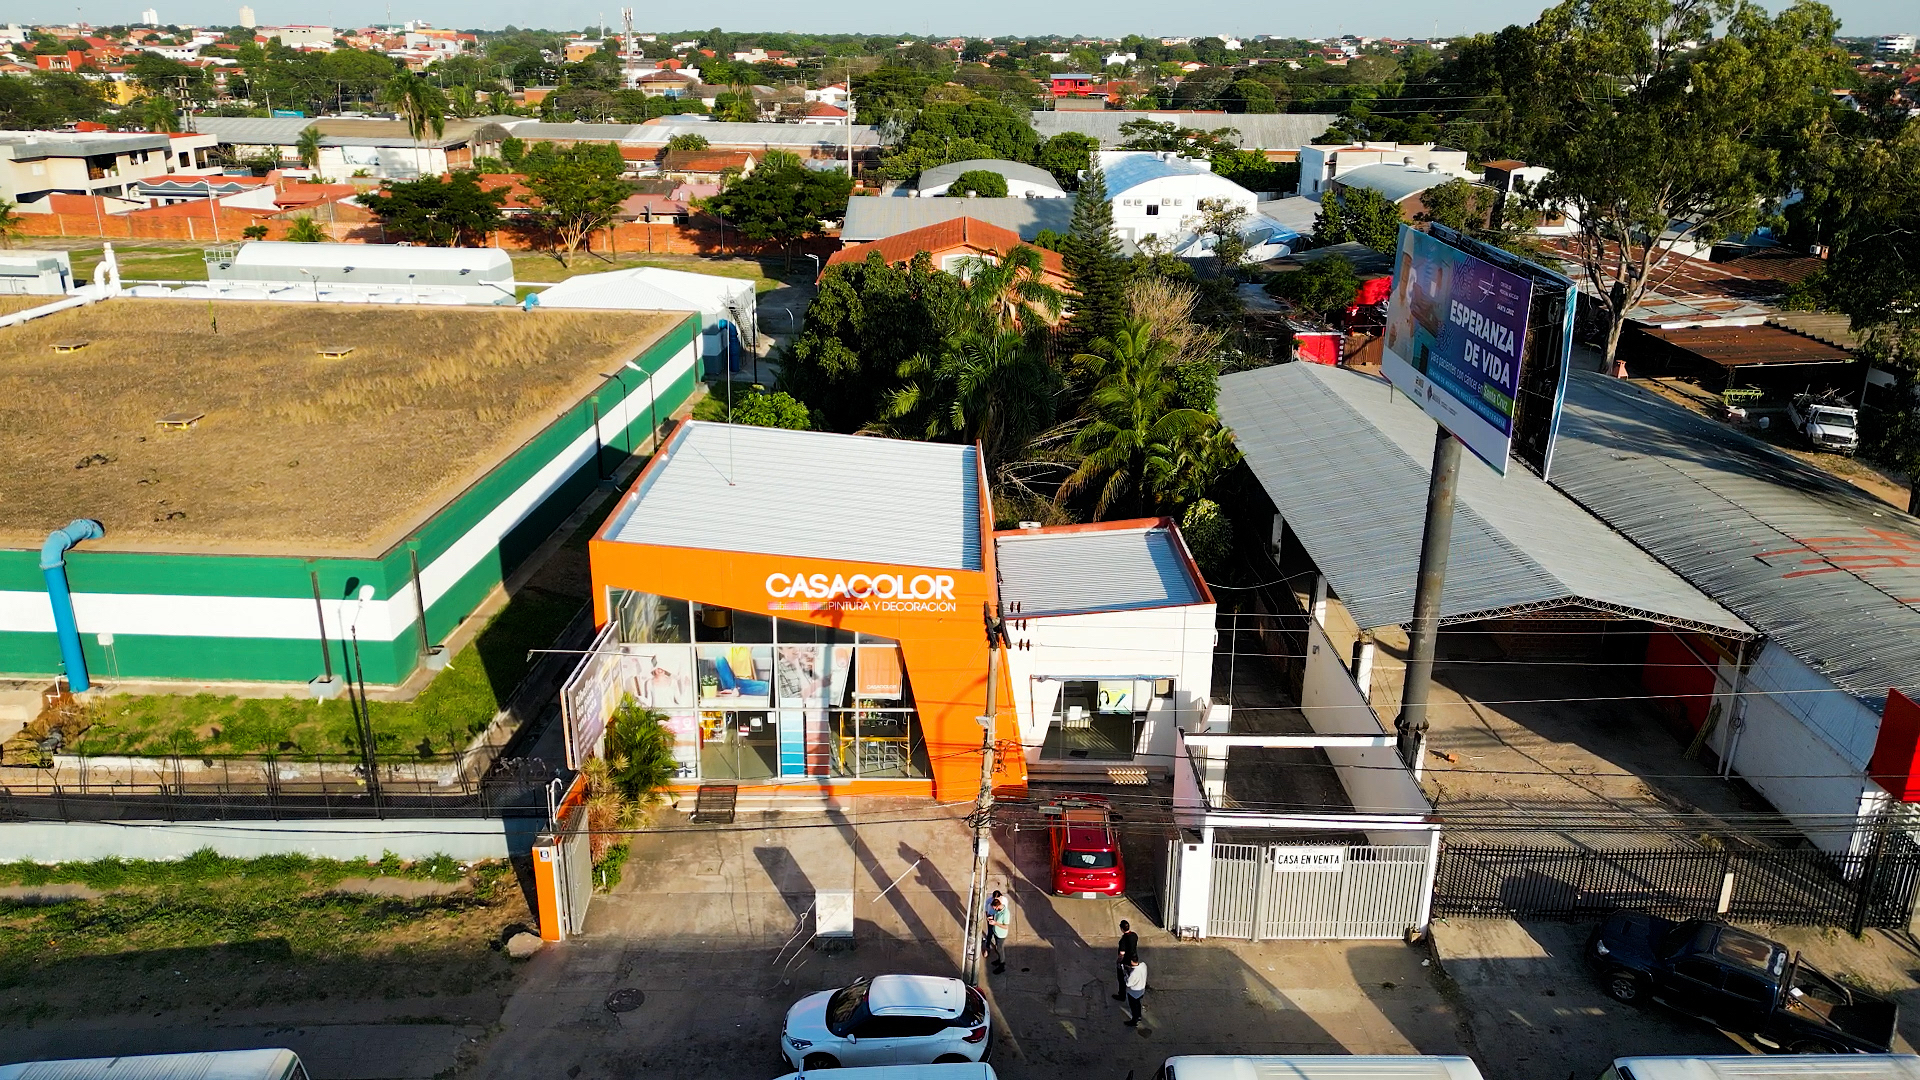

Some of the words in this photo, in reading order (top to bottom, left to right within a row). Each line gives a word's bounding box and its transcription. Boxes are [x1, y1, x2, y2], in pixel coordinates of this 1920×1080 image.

[1449, 299, 1515, 357] ESPERANZA
[1463, 338, 1481, 368] DE
[1482, 348, 1510, 389] VIDA
[1439, 357, 1457, 376] pacientes
[1484, 385, 1496, 404] Santa
[1496, 393, 1508, 411] Cruz
[765, 573, 956, 600] CASACOLOR
[828, 601, 870, 611] PINTURA
[873, 602, 880, 611] Y
[882, 600, 956, 612] DECORACIÓN
[1278, 854, 1299, 865] CASA
[1300, 854, 1312, 865] EN
[1313, 854, 1340, 865] VENTA
